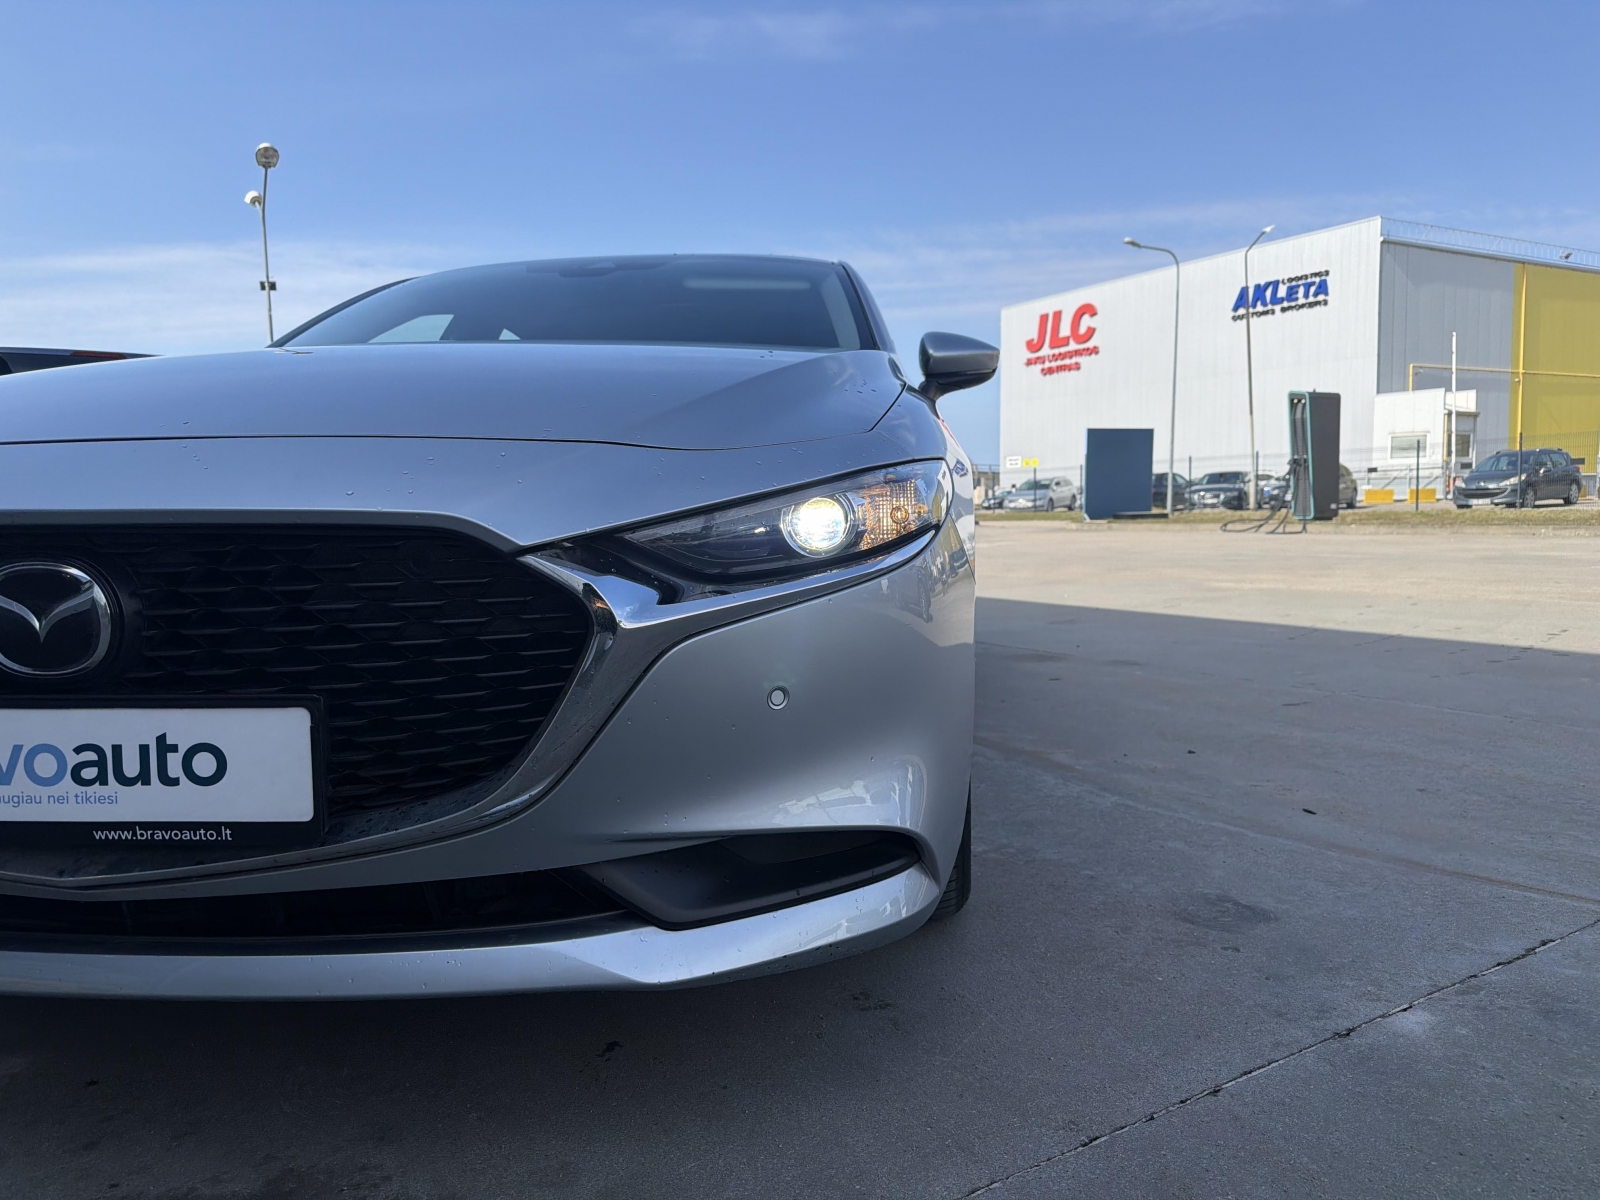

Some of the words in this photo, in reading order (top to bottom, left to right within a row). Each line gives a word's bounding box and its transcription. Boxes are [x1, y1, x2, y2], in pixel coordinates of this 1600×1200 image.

[1232, 278, 1329, 313] AKLETA
[1280, 299, 1328, 313] BROKERS
[1025, 302, 1098, 353] JLC
[0, 791, 42, 808] ugiau
[47, 791, 69, 805] nei
[74, 790, 118, 805] tikiesi
[92, 825, 233, 841] www.bravoauto.lt
